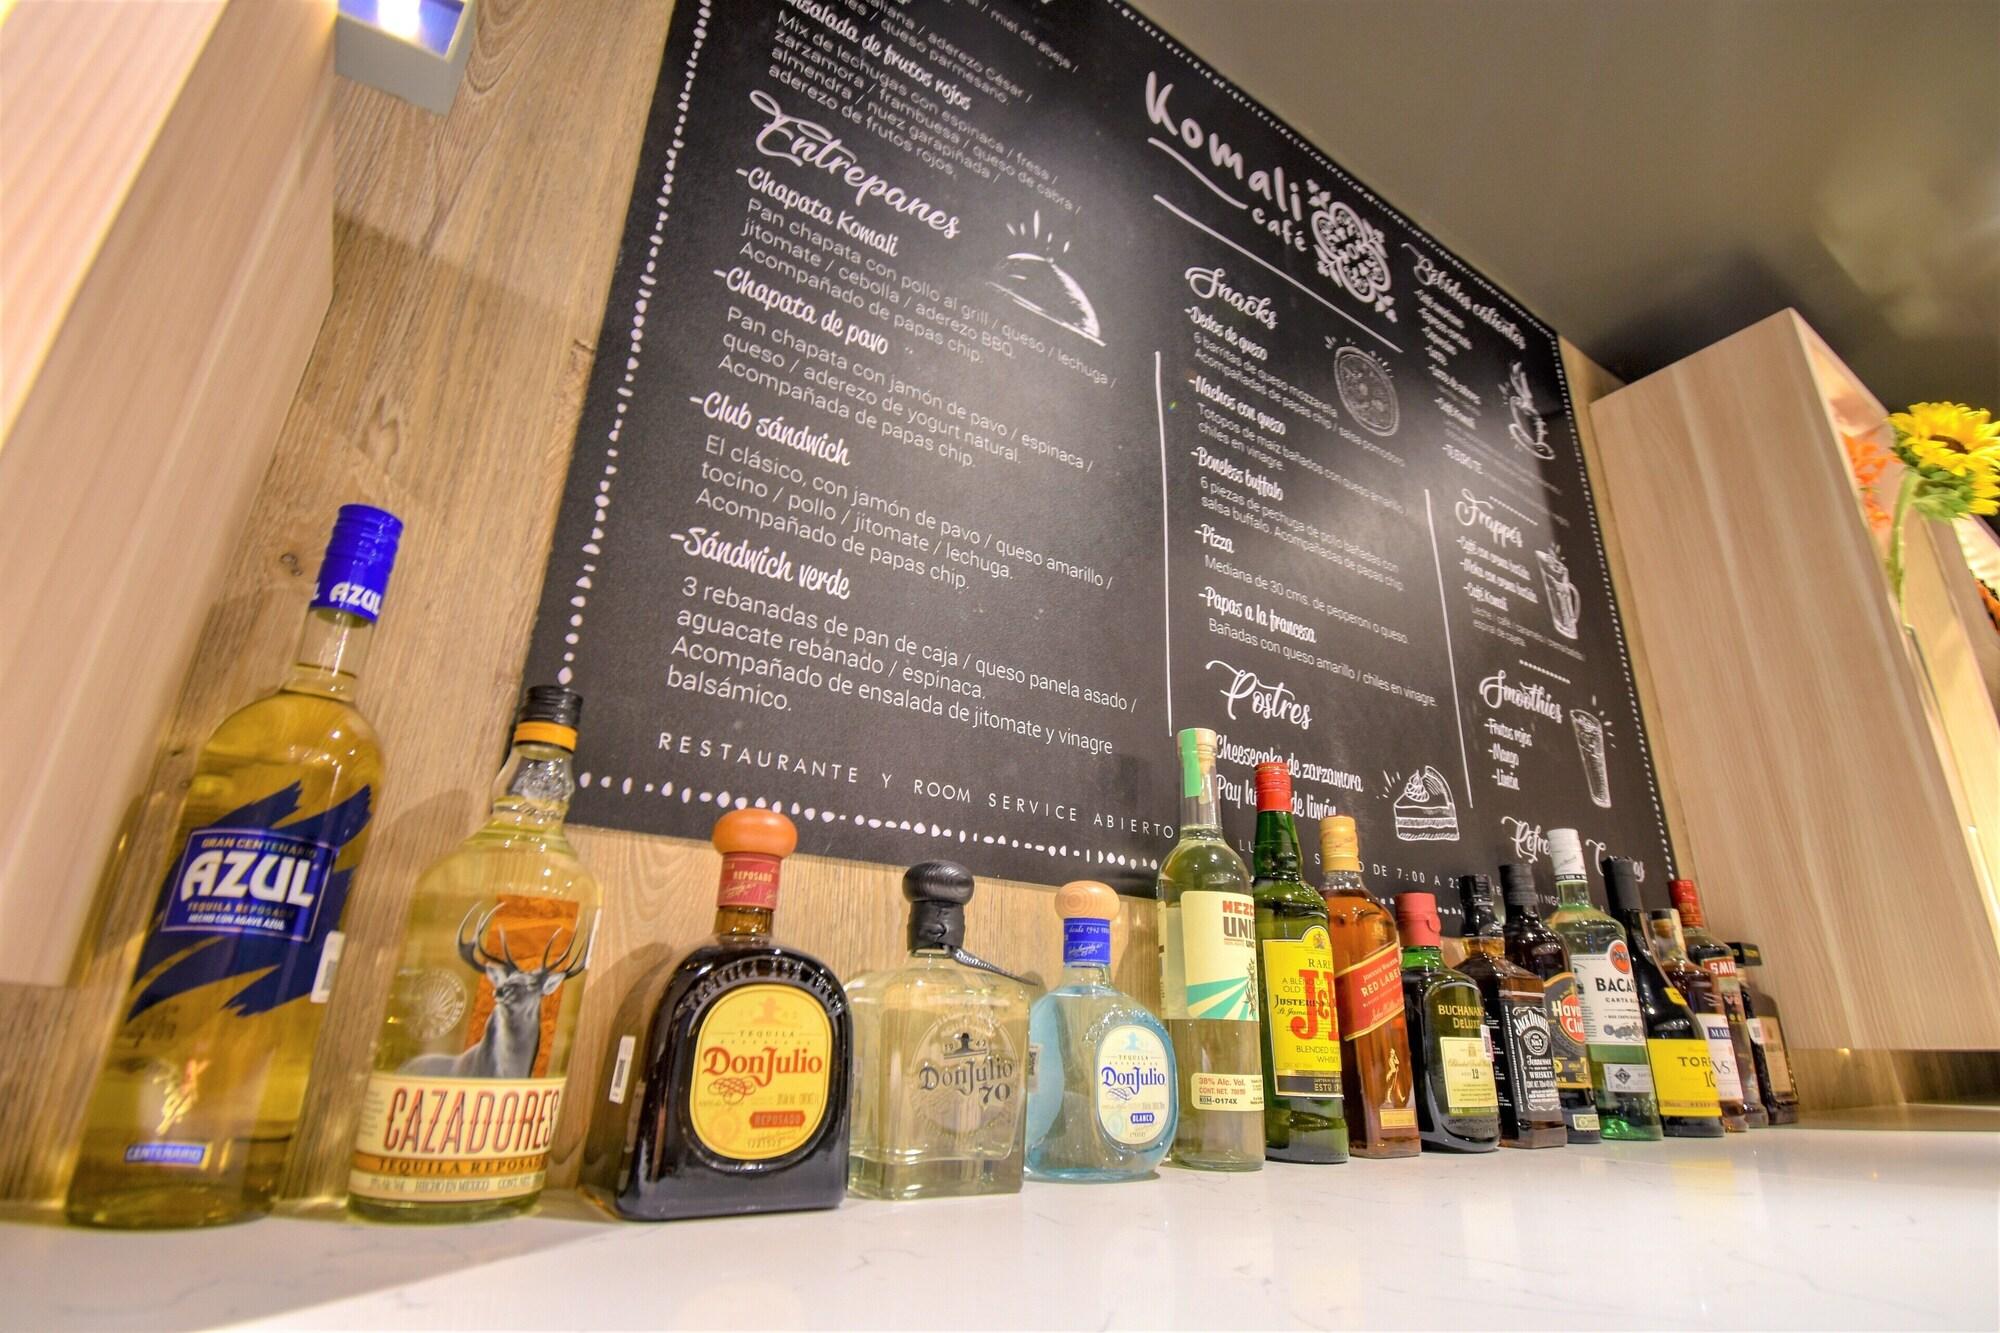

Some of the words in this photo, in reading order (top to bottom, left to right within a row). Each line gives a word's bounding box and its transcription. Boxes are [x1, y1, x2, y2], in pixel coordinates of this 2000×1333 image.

[771, 46, 851, 99] almendra
[867, 101, 905, 130] nuez
[908, 125, 990, 178] garapiñada
[778, 9, 808, 38] Mix
[812, 33, 833, 52] de
[836, 44, 906, 96] lechugas
[910, 91, 938, 114] con
[941, 110, 1004, 153] espinaca
[1016, 152, 1049, 180] fresa
[749, 89, 959, 238] Entrepanes
[1145, 70, 1302, 221] Komali
[1252, 207, 1306, 251] café
[739, 241, 864, 308] Acompañado
[868, 301, 889, 320] de
[893, 314, 943, 344] papas
[946, 338, 983, 363] chip.
[740, 217, 821, 266] jitomate
[838, 266, 899, 303] cebolla
[915, 302, 977, 340] aderezo
[981, 330, 1015, 358] BBQ.
[747, 197, 784, 227] Pan
[788, 221, 861, 264] chapata
[865, 258, 896, 281] con
[900, 275, 939, 301] pollo
[943, 296, 957, 310] al
[961, 304, 988, 325] grill
[1001, 324, 1045, 352] queso
[1058, 348, 1108, 384] lechuga
[1184, 266, 1278, 329] Snacks
[717, 354, 849, 418] Acompañada
[854, 408, 877, 428] de
[881, 421, 933, 450] papas
[938, 442, 975, 467] chip.
[722, 333, 784, 367] queso
[803, 366, 876, 404] aderezo
[881, 396, 902, 415] de
[901, 405, 960, 439] yogurt
[964, 431, 1021, 463] natural.
[727, 305, 765, 336] Pan
[771, 328, 847, 369] chapata
[852, 362, 884, 385] con
[887, 374, 942, 409] jamón
[946, 400, 966, 419] de
[970, 412, 1007, 436] pavo
[1021, 434, 1083, 468] espinaca
[689, 391, 751, 429] -Club
[755, 416, 850, 466] sándwich
[695, 487, 836, 546] Acompañado
[841, 535, 864, 556] de
[869, 547, 924, 574] papas
[930, 564, 968, 589] chip.
[701, 461, 767, 497] tocino
[788, 494, 836, 520] pollo
[852, 511, 929, 551] jitomate
[946, 542, 1013, 579] lechuga.
[705, 434, 725, 456] El
[730, 446, 806, 487] clásico,
[812, 476, 847, 499] con
[850, 490, 910, 520] jamón
[915, 509, 936, 529] de
[940, 521, 980, 544] pavo
[996, 540, 1042, 565] queso
[1046, 557, 1103, 586] amarillo
[1194, 523, 1234, 553] -Pizza
[329, 582, 382, 616] AZUL
[670, 527, 793, 581] -Sándwich
[798, 564, 850, 599] verde
[682, 576, 697, 596] 3
[703, 586, 817, 628] rebanadas
[823, 615, 848, 636] de
[853, 626, 888, 648] pan
[894, 634, 916, 655] de
[921, 645, 957, 667] caja
[975, 659, 1025, 683] queso
[1029, 674, 1079, 698] panela
[1083, 688, 1127, 710] asado
[1198, 586, 1242, 617] -Papas
[1244, 605, 1254, 621] a
[1255, 603, 1268, 626] la
[1269, 608, 1316, 643] francesa
[666, 664, 791, 710] balsámico.
[676, 609, 782, 648] aguacate
[788, 637, 883, 673] rebanado
[902, 659, 985, 699] espinaca.
[670, 636, 822, 687] Acompañado
[828, 673, 852, 694] de
[858, 683, 942, 715] ensalada
[948, 701, 969, 721] de
[972, 706, 1041, 737] jitomate
[1045, 727, 1054, 744] y
[1058, 727, 1112, 754] vinagre
[1205, 659, 1312, 729] Postres
[1478, 669, 1562, 723] Smoothies
[658, 732, 857, 782] RESTAURANTE
[881, 772, 892, 788] Y
[914, 779, 970, 802] ROOM
[988, 792, 1076, 821] SERVICE
[1093, 812, 1173, 838] ABIERTO
[181, 851, 314, 908] AZUL
[1222, 900, 1255, 914] MEZC
[1372, 863, 1387, 876] DE
[1396, 867, 1425, 883] 7:00
[1223, 916, 1256, 940] UNI
[1361, 981, 1379, 997] RED
[1380, 967, 1401, 988] LABEL
[1596, 978, 1636, 992] BACA
[384, 1088, 560, 1154] CAZADORES
[978, 1082, 1011, 1104] 70
[378, 1158, 460, 1176] TEQUILA
